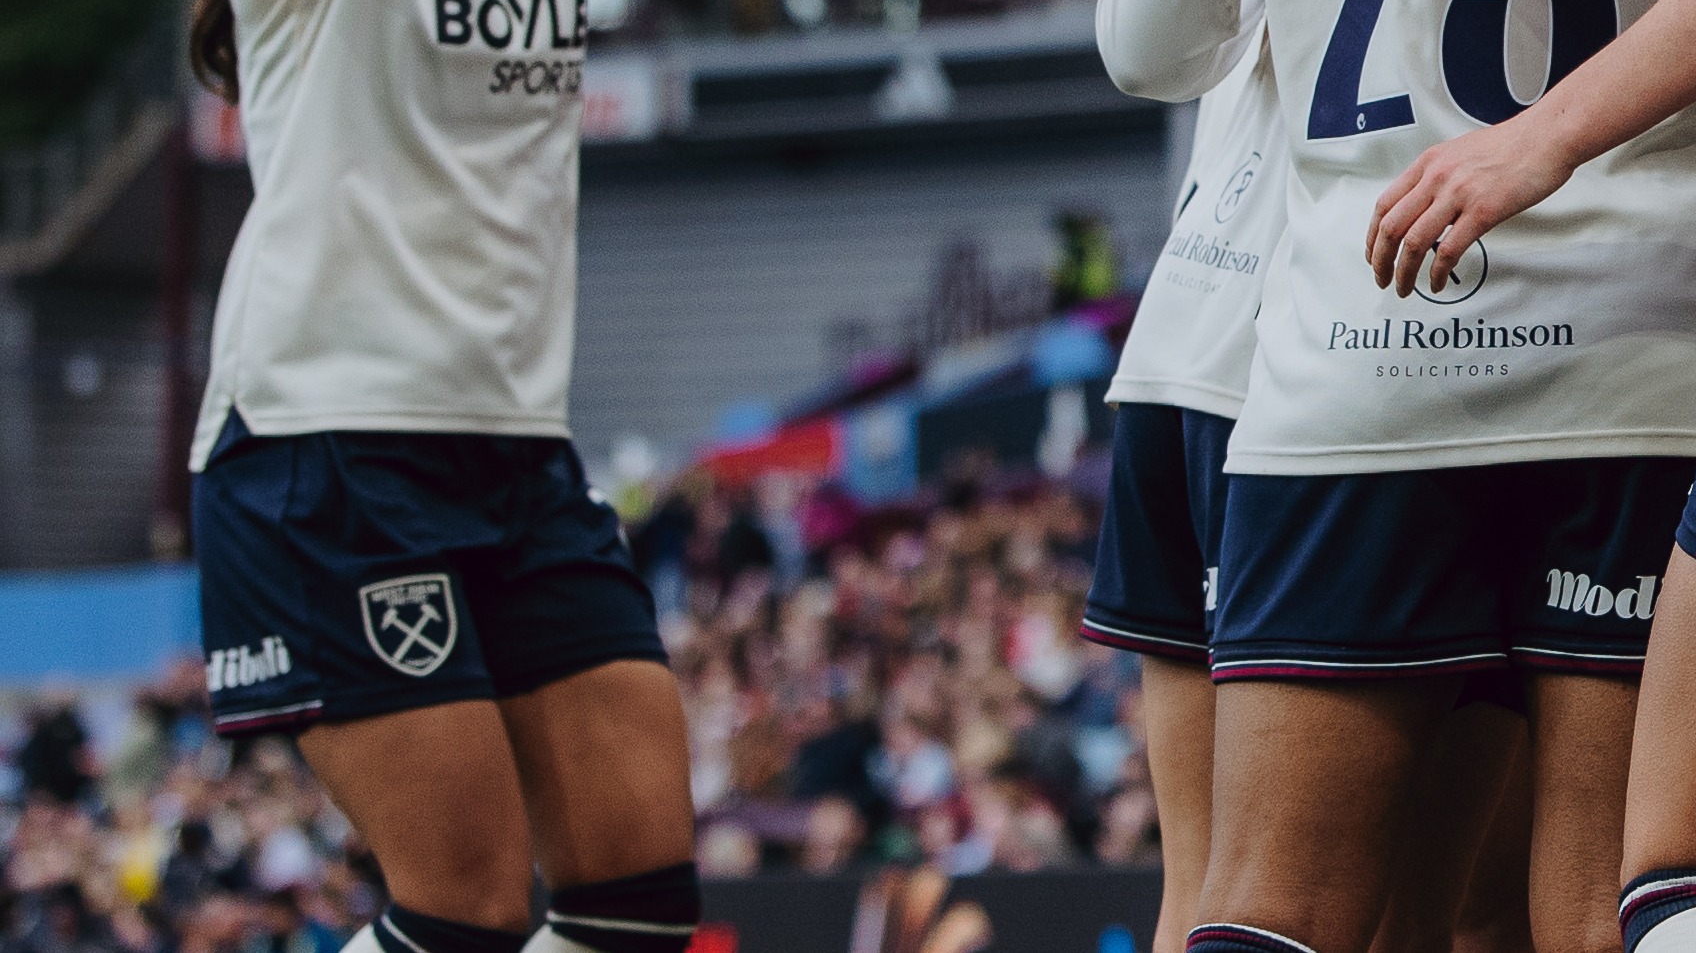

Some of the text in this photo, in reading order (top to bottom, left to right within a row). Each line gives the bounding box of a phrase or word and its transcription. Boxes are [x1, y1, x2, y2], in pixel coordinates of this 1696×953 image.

[1327, 317, 1575, 350] Paul Robinson
[1376, 364, 1509, 377] SOLICITORS
